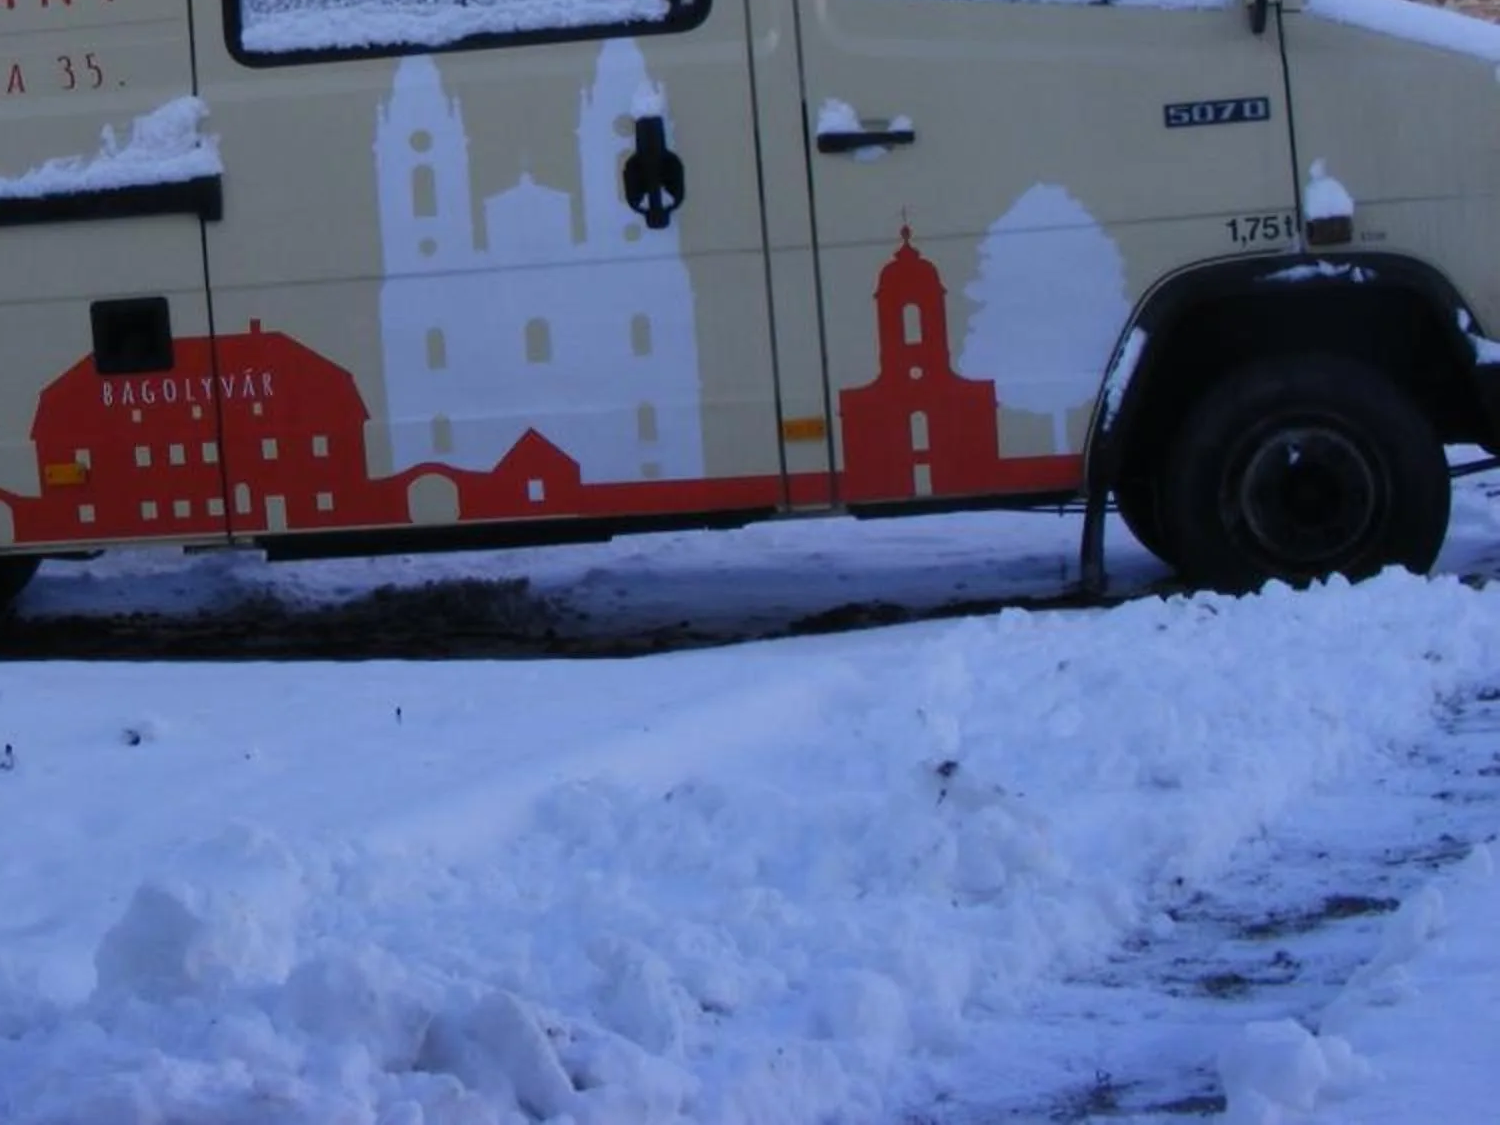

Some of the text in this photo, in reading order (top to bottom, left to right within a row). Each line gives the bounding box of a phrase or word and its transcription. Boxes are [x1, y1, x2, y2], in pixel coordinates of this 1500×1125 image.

[57, 52, 127, 92] 35.
[1225, 216, 1280, 246] 1,75
[103, 368, 273, 407] BAGOLYVÁR
